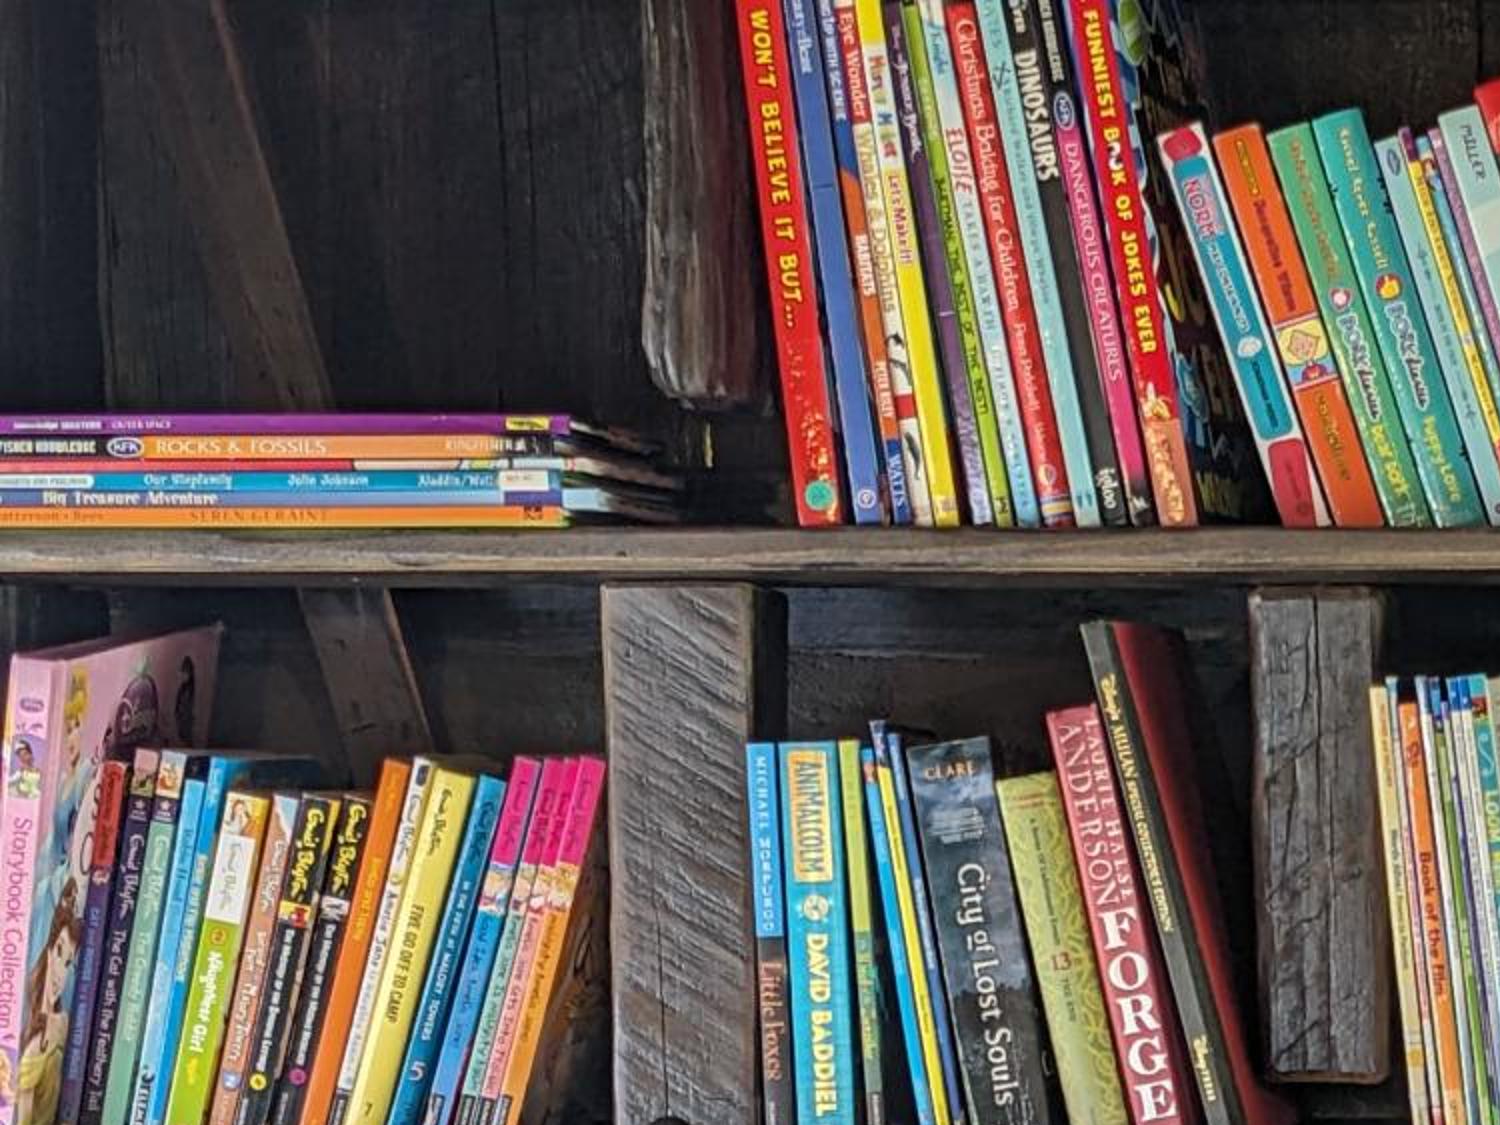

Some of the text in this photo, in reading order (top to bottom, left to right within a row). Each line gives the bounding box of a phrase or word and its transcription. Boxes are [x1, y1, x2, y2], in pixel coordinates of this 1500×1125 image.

[751, 10, 777, 89] WON'T
[839, 11, 866, 119] Eye Wonder
[1083, 9, 1117, 119] FUNNIEST
[1014, 50, 1060, 182] DINOSAURS
[761, 101, 791, 205] BELIEVE
[956, 18, 1019, 311] Christmas Baking for Children
[1458, 123, 1486, 181] MILLER
[774, 216, 796, 240] IT
[856, 127, 881, 202] Whales
[871, 227, 896, 312] Dolphins
[1115, 195, 1134, 222] OF
[1064, 143, 1123, 381] DANGEROUS CREATURES
[1121, 231, 1147, 297] JOKES
[1134, 305, 1157, 353] EVER
[156, 440, 327, 454] ROCKS & FOSSILS
[75, 492, 140, 504] Treasure
[146, 491, 217, 504] Adventure
[1095, 468, 1117, 510] igloo
[755, 756, 770, 828] MICHAEL
[923, 761, 976, 779] CLARE
[1058, 724, 1121, 905] ANDERSON
[6, 815, 34, 924] Storybook
[123, 832, 143, 872] Enid
[289, 808, 325, 902] Enid Blyton
[331, 804, 366, 899] Enid Blyton
[1105, 820, 1134, 900] HALSE
[1419, 850, 1437, 898] Book
[955, 864, 985, 925] City
[1426, 899, 1439, 918] of
[106, 952, 122, 976] Cat
[110, 928, 127, 951] The
[383, 903, 424, 1024] FIVE GO OFF TO CAMP
[1051, 953, 1073, 971] 13
[1427, 919, 1441, 949] the
[98, 1008, 114, 1031] the
[102, 977, 119, 1007] with
[419, 951, 452, 1042] MALORY TOWERS
[760, 961, 784, 1020] Little
[972, 959, 999, 1021] Lost
[1099, 906, 1181, 1124] FORGE
[187, 1023, 207, 1053] Girl
[807, 933, 836, 1117] DAVID BADDIEL
[88, 1031, 110, 1086] Feathery
[407, 1058, 427, 1084] 5
[984, 1025, 1014, 1107] Souls
